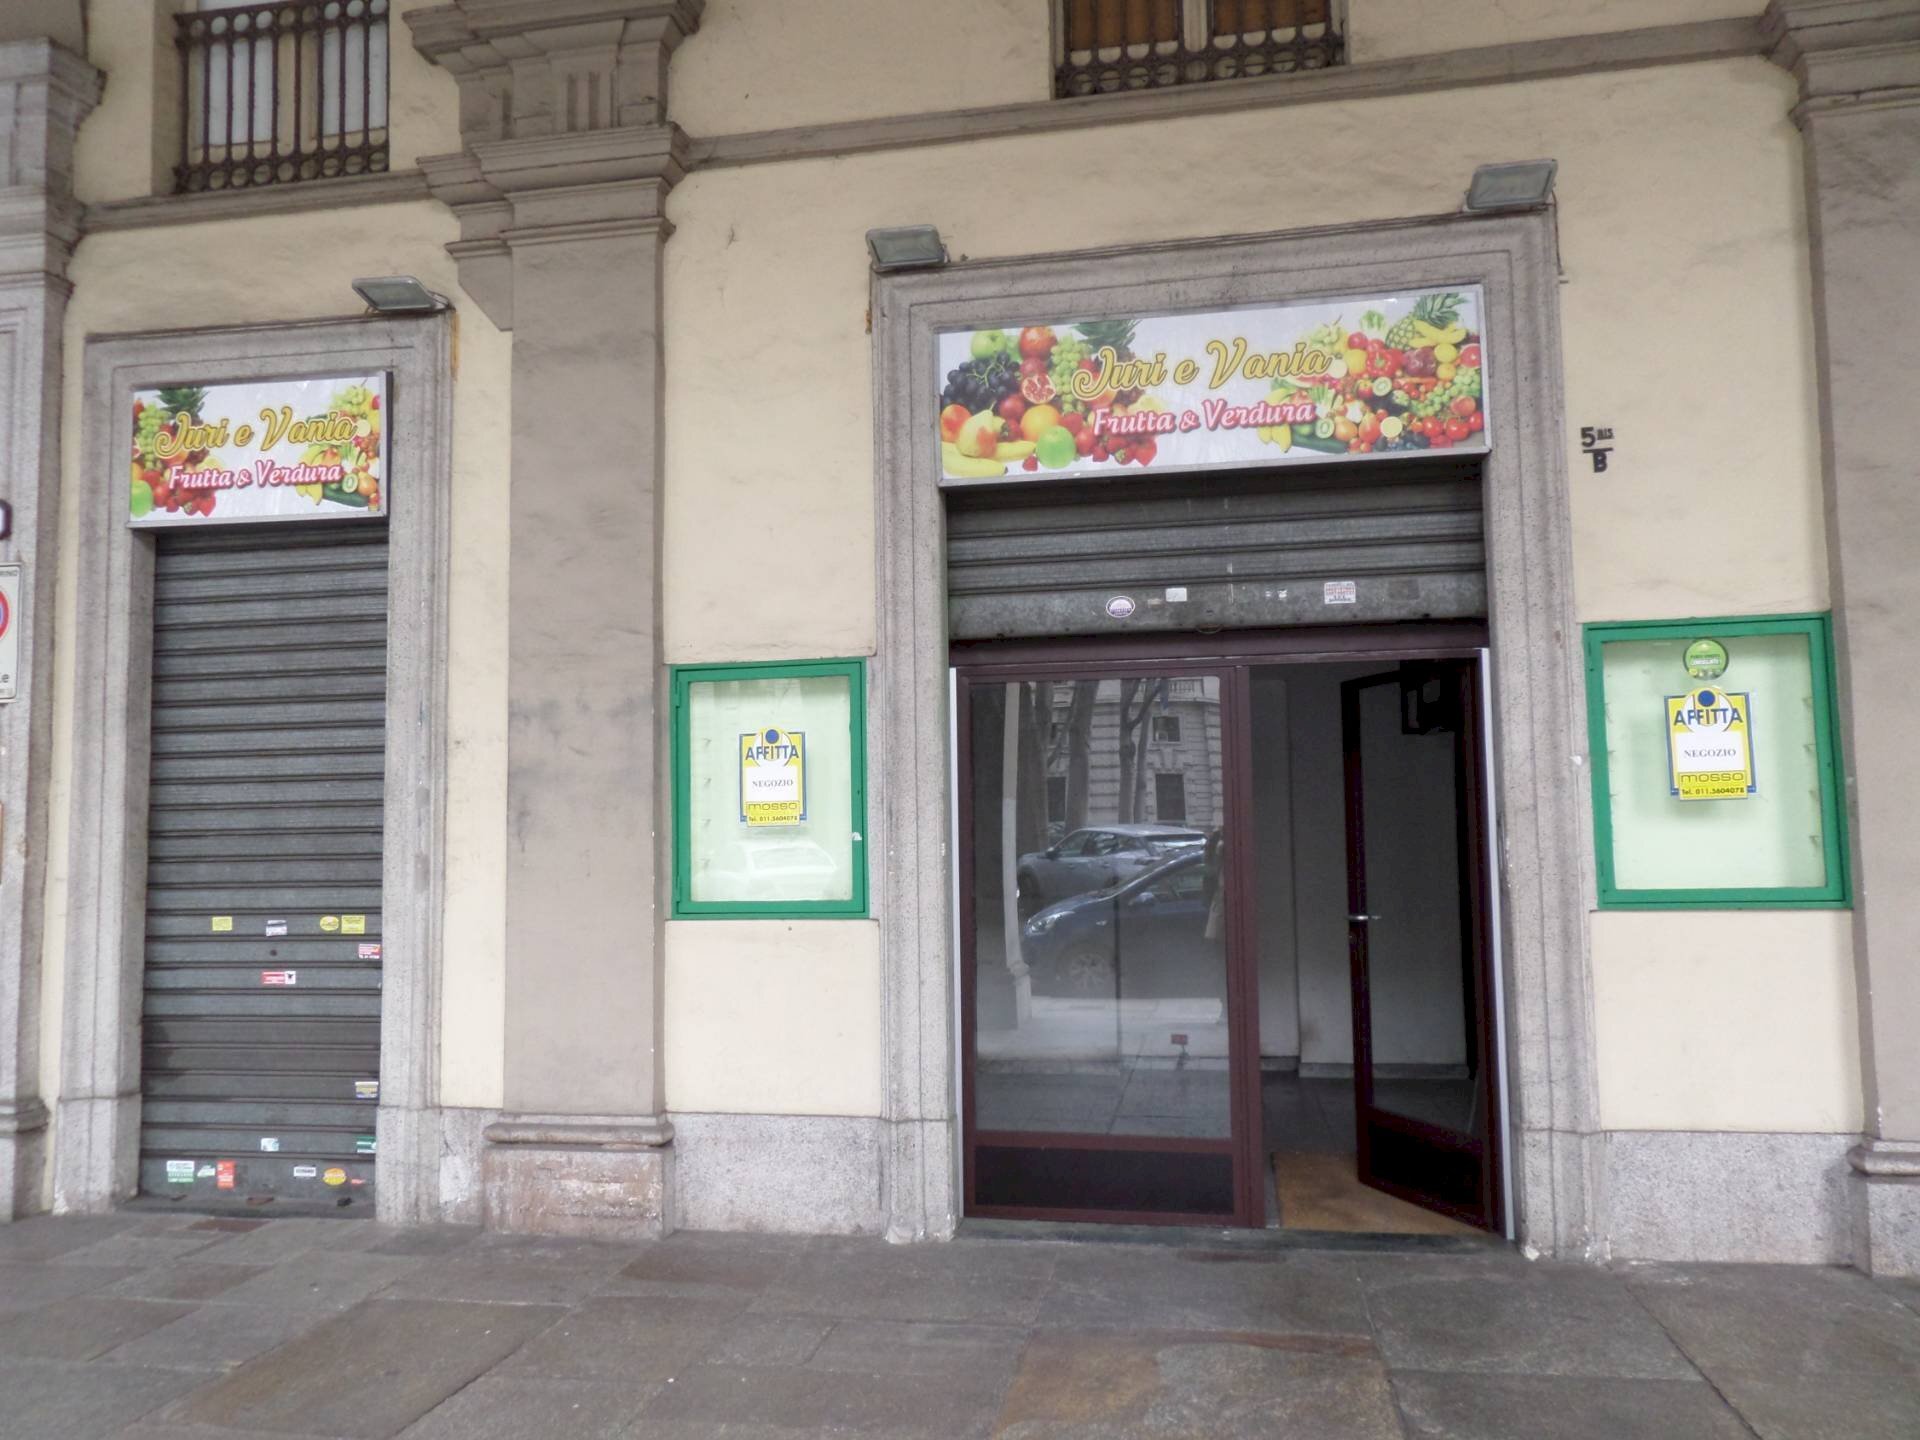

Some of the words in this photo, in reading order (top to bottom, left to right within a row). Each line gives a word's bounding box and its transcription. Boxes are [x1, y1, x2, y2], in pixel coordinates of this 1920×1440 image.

[1072, 347, 1168, 399] Juri
[1173, 359, 1199, 385] e
[1206, 337, 1332, 389] Vania
[1093, 408, 1175, 436] Frutta
[1179, 411, 1199, 431] &
[1203, 399, 1316, 430] Verdura
[154, 411, 229, 458] Juri
[234, 424, 254, 445] e
[260, 406, 357, 451] Vania
[1593, 451, 1608, 473] B
[168, 464, 232, 490] Frutta
[235, 469, 252, 488] &
[255, 459, 344, 487] Verdura
[1673, 707, 1743, 726] AFFITTA
[745, 745, 799, 760] AFFITTA
[1684, 748, 1737, 758] NEGOZIO
[752, 779, 794, 788] NEGOZIO
